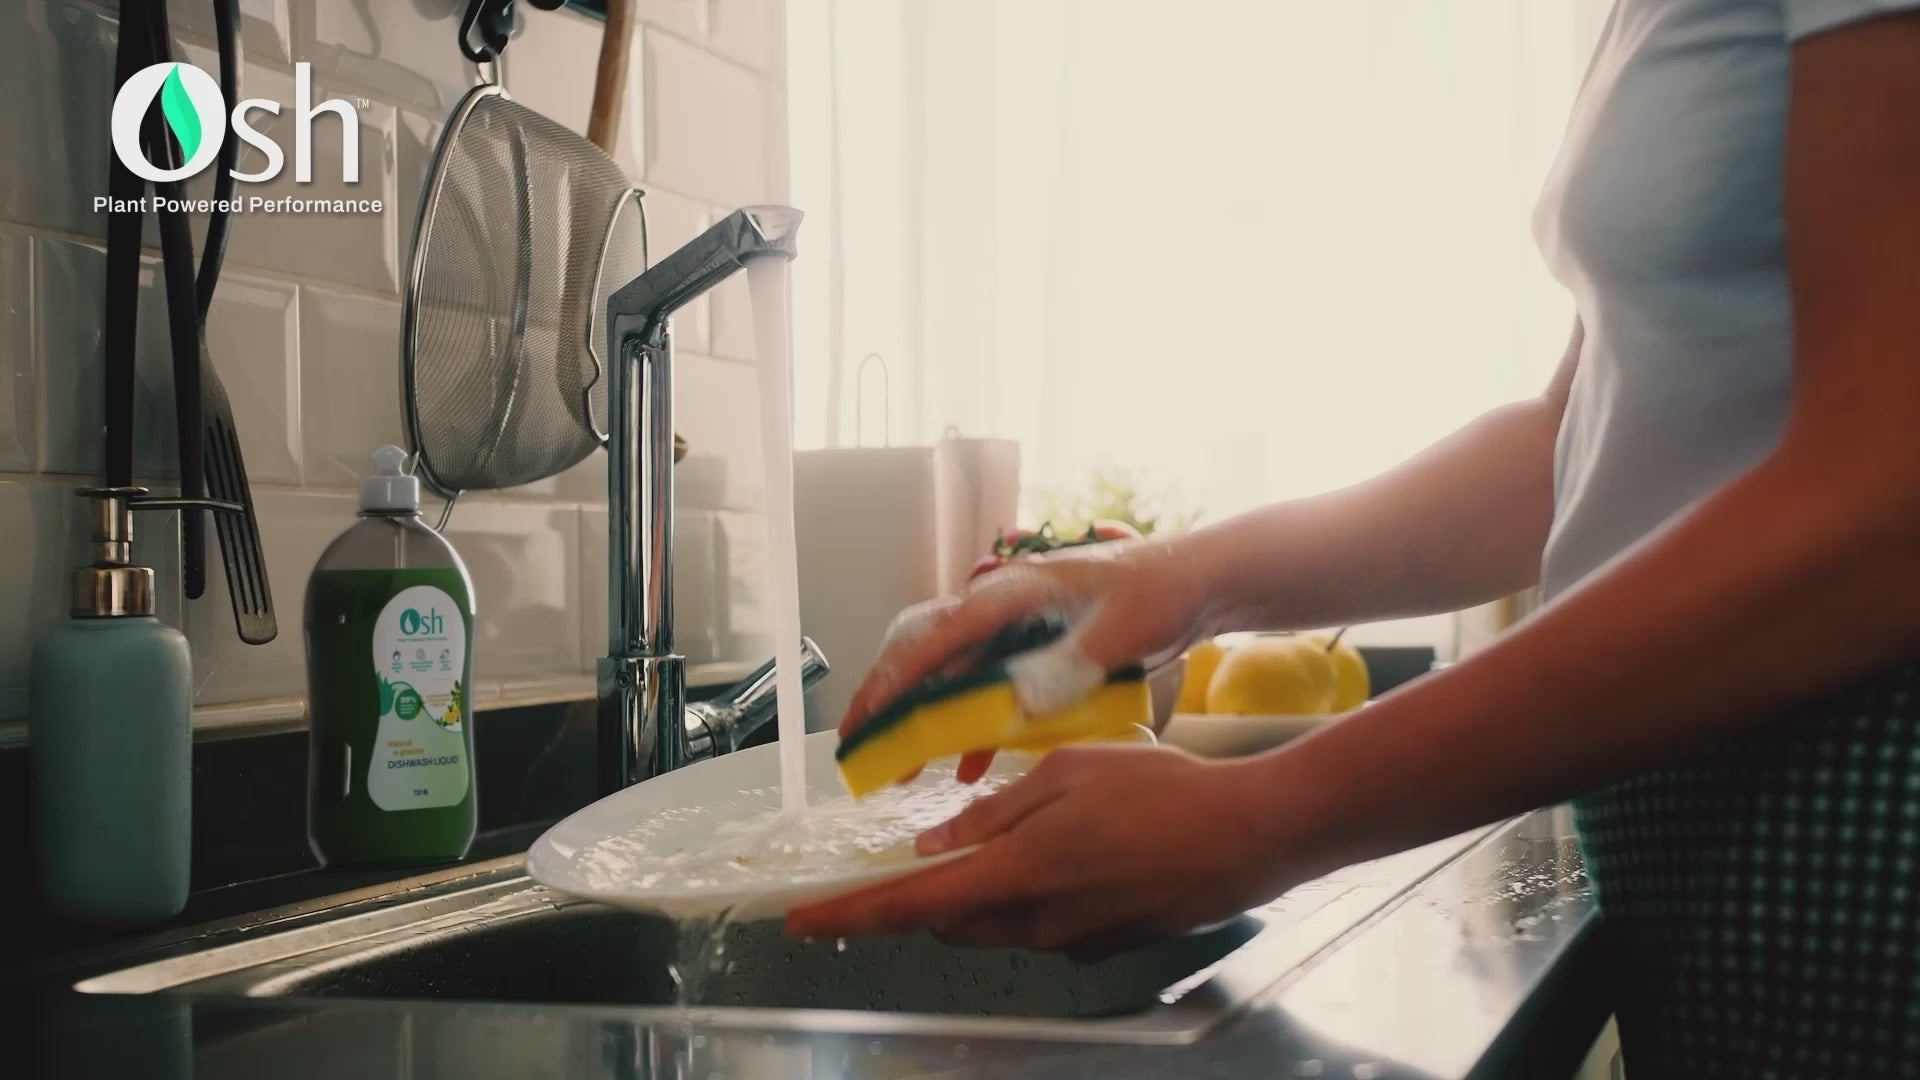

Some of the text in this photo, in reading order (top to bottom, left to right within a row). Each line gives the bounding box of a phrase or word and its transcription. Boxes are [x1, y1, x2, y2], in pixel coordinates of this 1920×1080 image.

[399, 607, 444, 636] Osh
[387, 755, 459, 769] DISHWASH LIQUID
